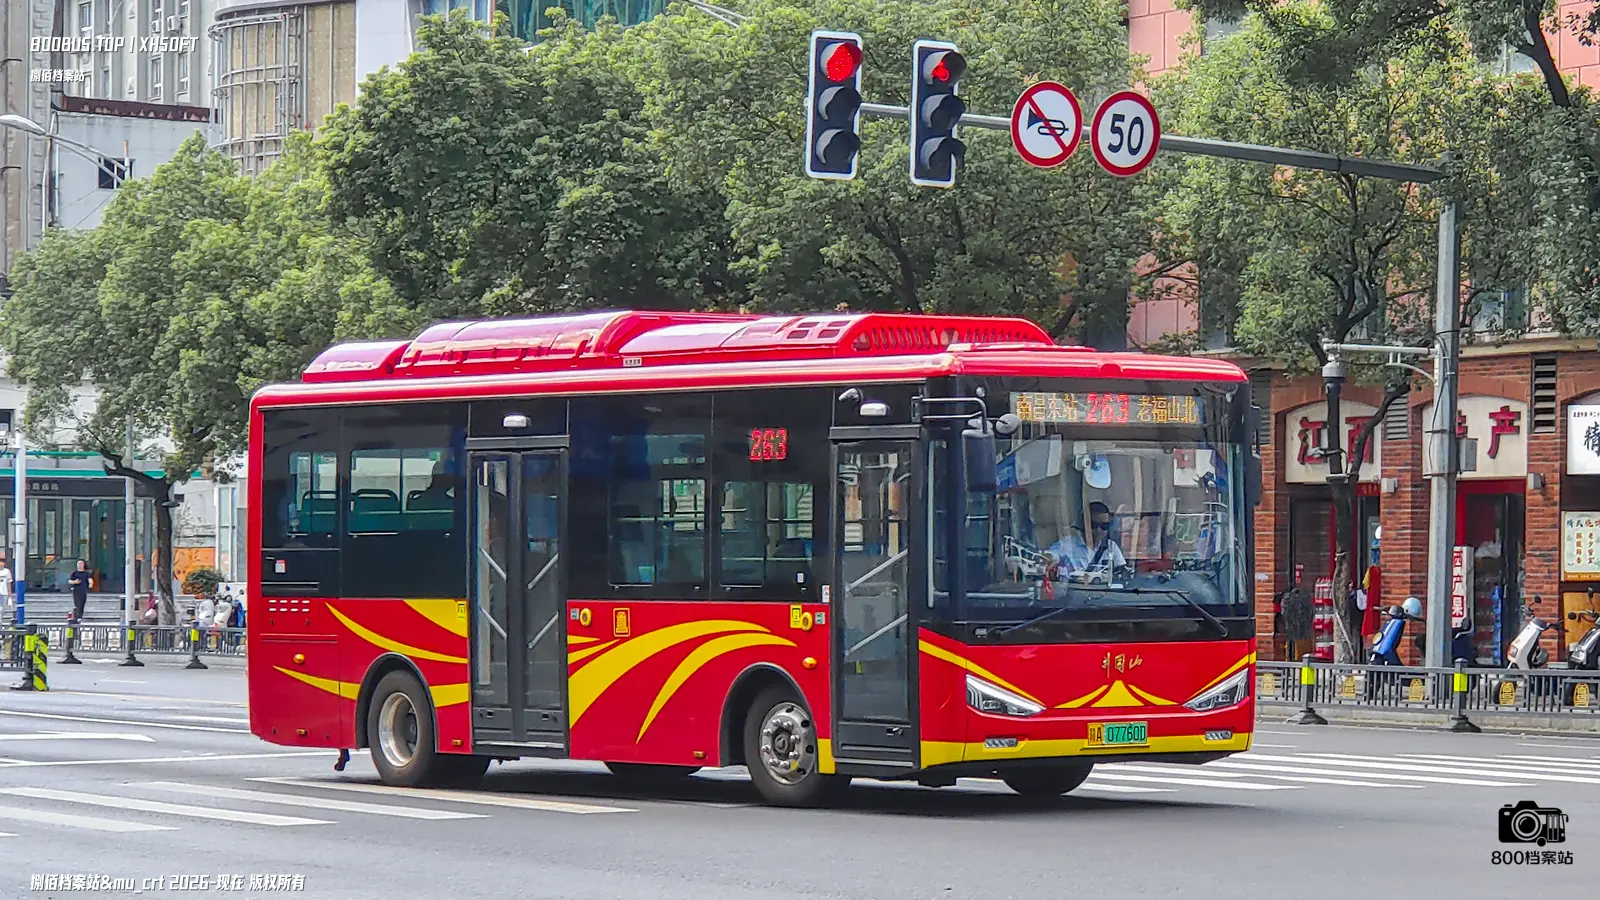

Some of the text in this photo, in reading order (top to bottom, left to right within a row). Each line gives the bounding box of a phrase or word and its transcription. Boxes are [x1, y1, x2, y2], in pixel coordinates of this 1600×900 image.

[1107, 112, 1144, 156] 50
[1016, 392, 1197, 423] 南昌东站 263 老福山北
[750, 428, 787, 461] 263
